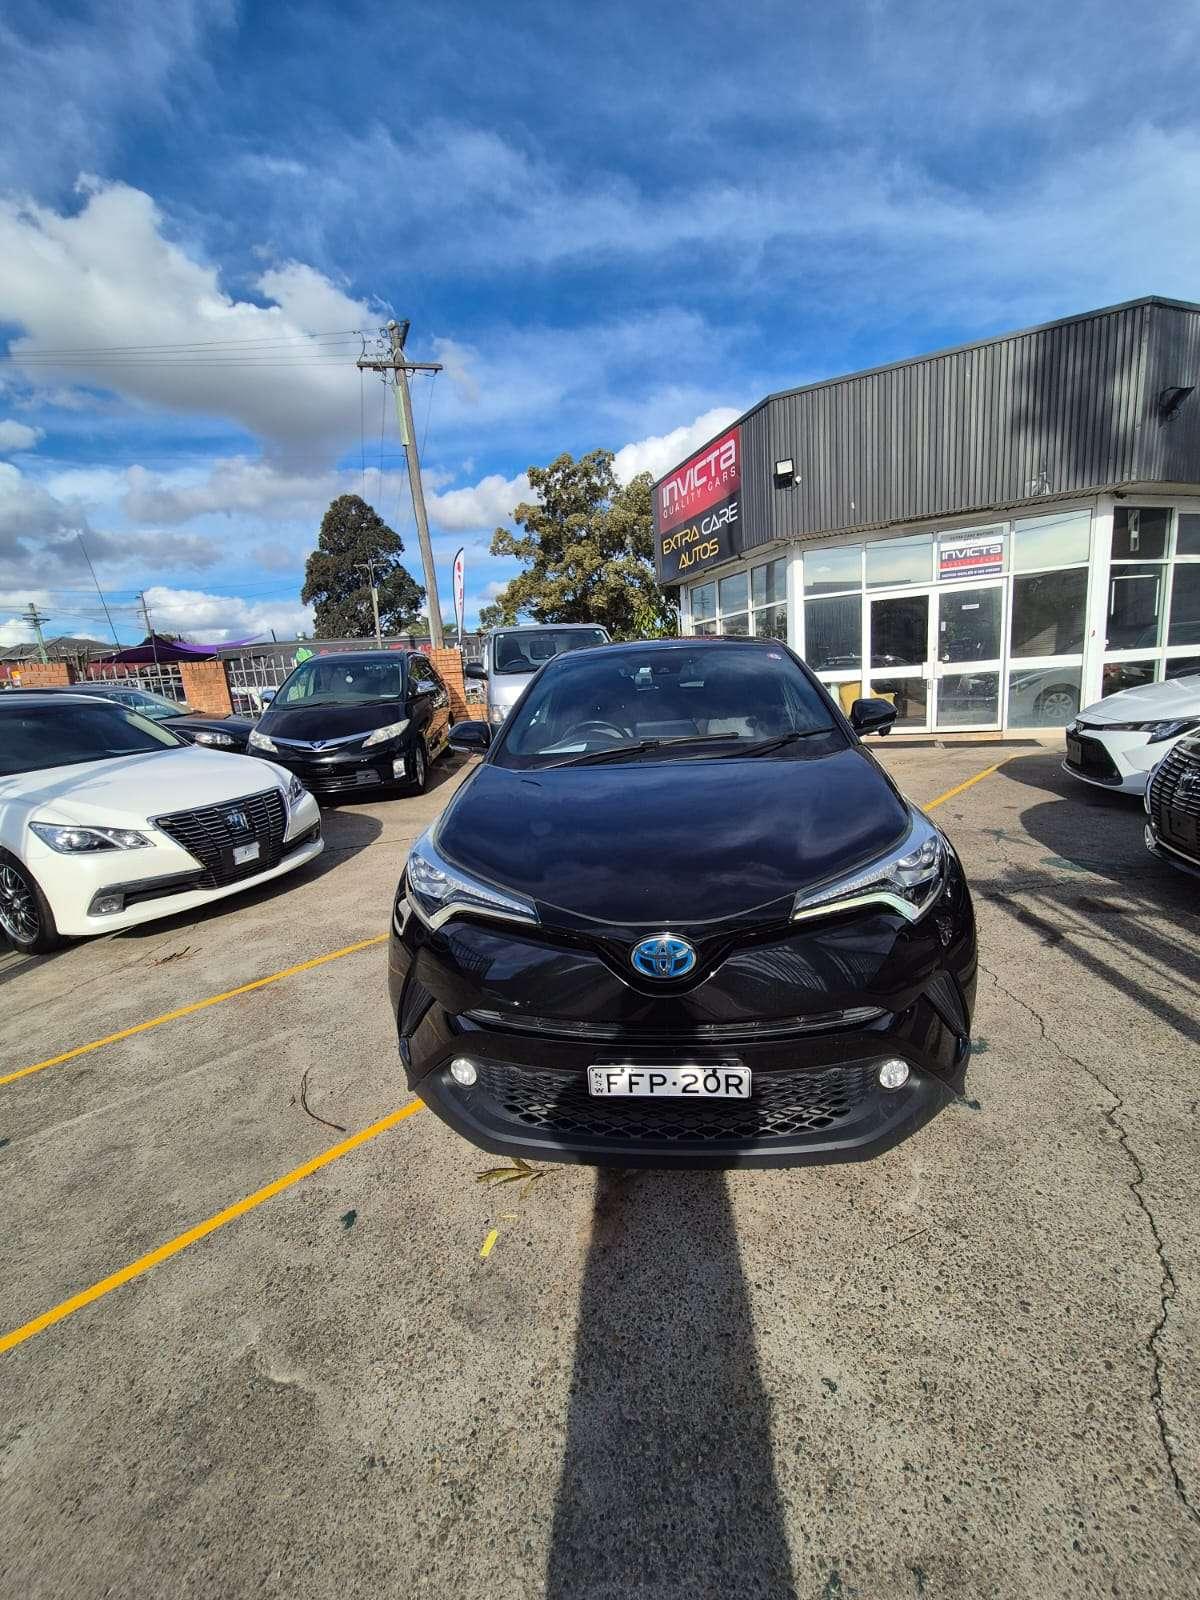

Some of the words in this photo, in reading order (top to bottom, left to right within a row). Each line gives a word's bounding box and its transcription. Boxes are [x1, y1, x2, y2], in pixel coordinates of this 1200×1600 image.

[663, 487, 702, 519] QUALITY
[707, 466, 736, 492] CARS
[663, 525, 700, 555] EXTRA
[701, 502, 738, 535] CARE
[678, 538, 719, 569] AUTOS
